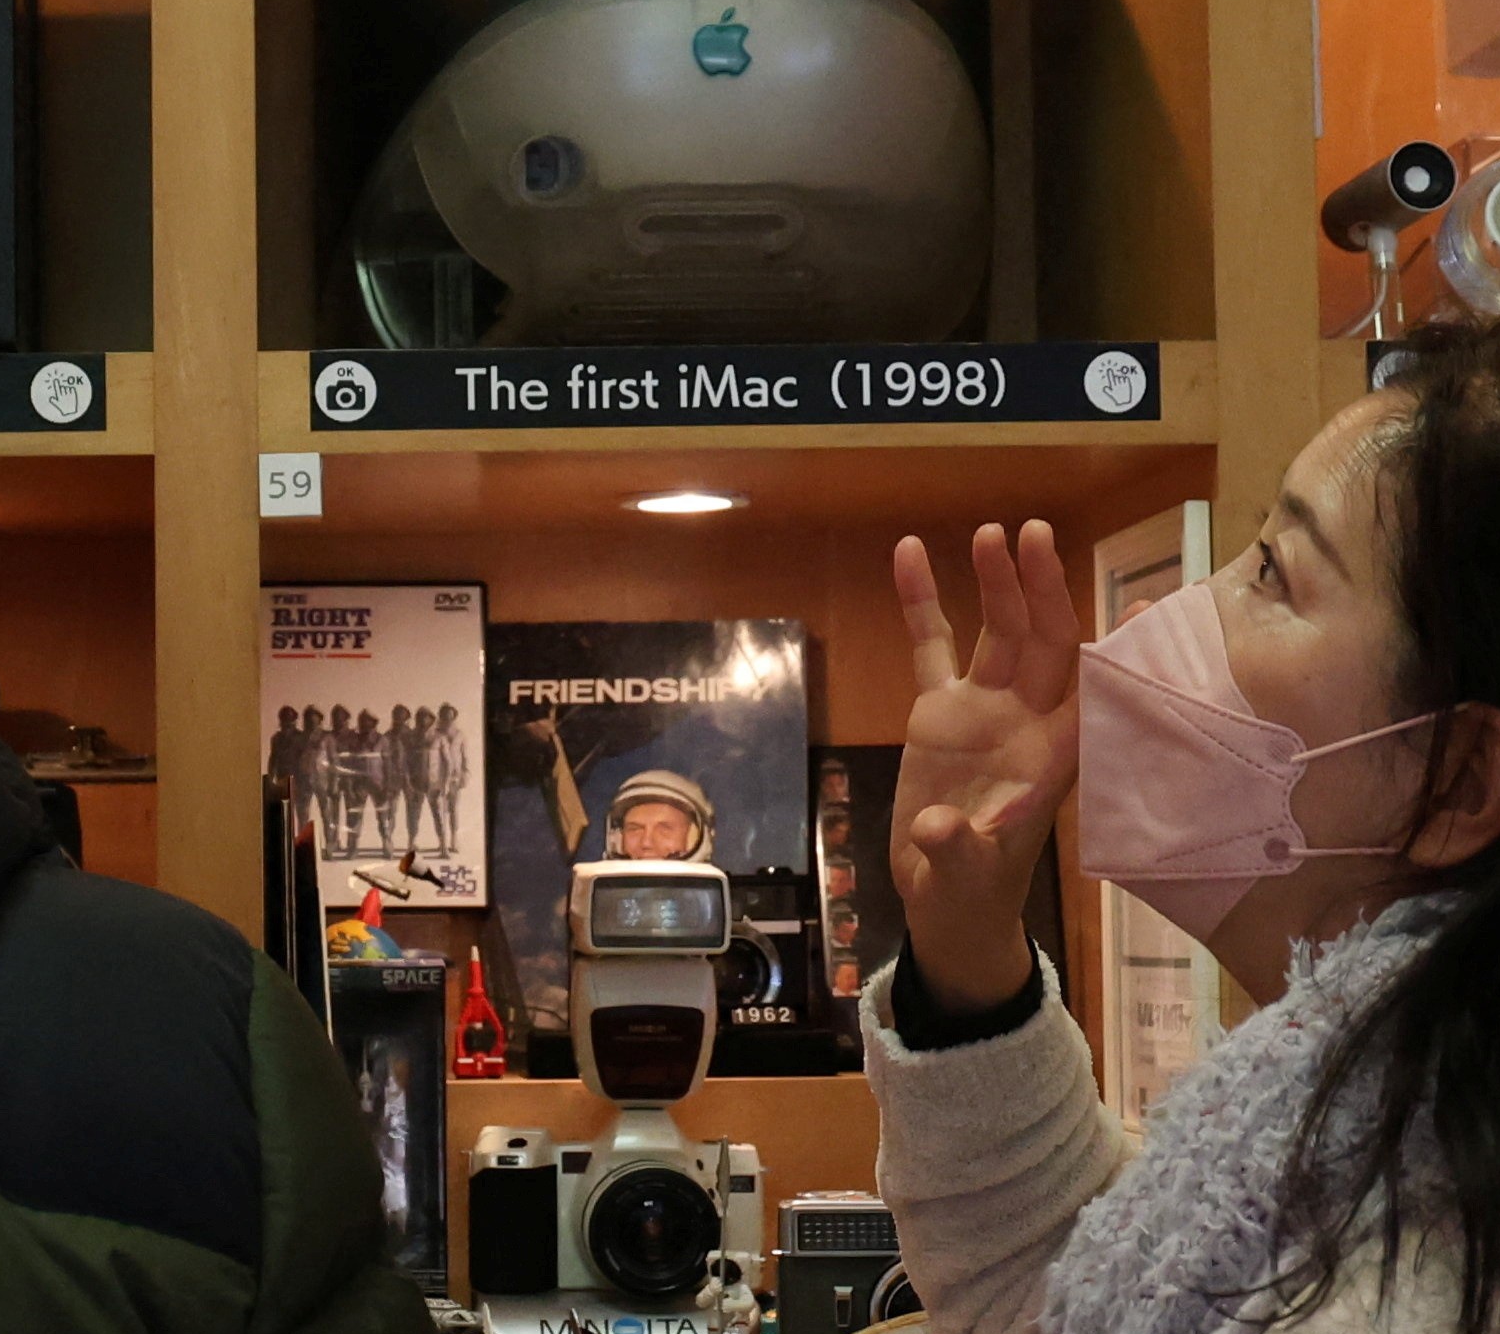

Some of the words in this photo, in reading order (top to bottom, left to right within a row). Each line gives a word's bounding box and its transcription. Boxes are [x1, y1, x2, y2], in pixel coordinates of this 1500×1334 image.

[455, 366, 549, 412] The
[567, 364, 660, 411] first
[678, 363, 799, 410] iMac
[831, 358, 1007, 410] (1998)
[267, 470, 312, 501] 59
[272, 593, 308, 606] THE
[434, 593, 472, 605] DVD
[271, 608, 372, 628] RIGHT
[271, 630, 372, 650] STUFF
[382, 968, 443, 986] SPACE
[733, 1006, 792, 1024] 1962
